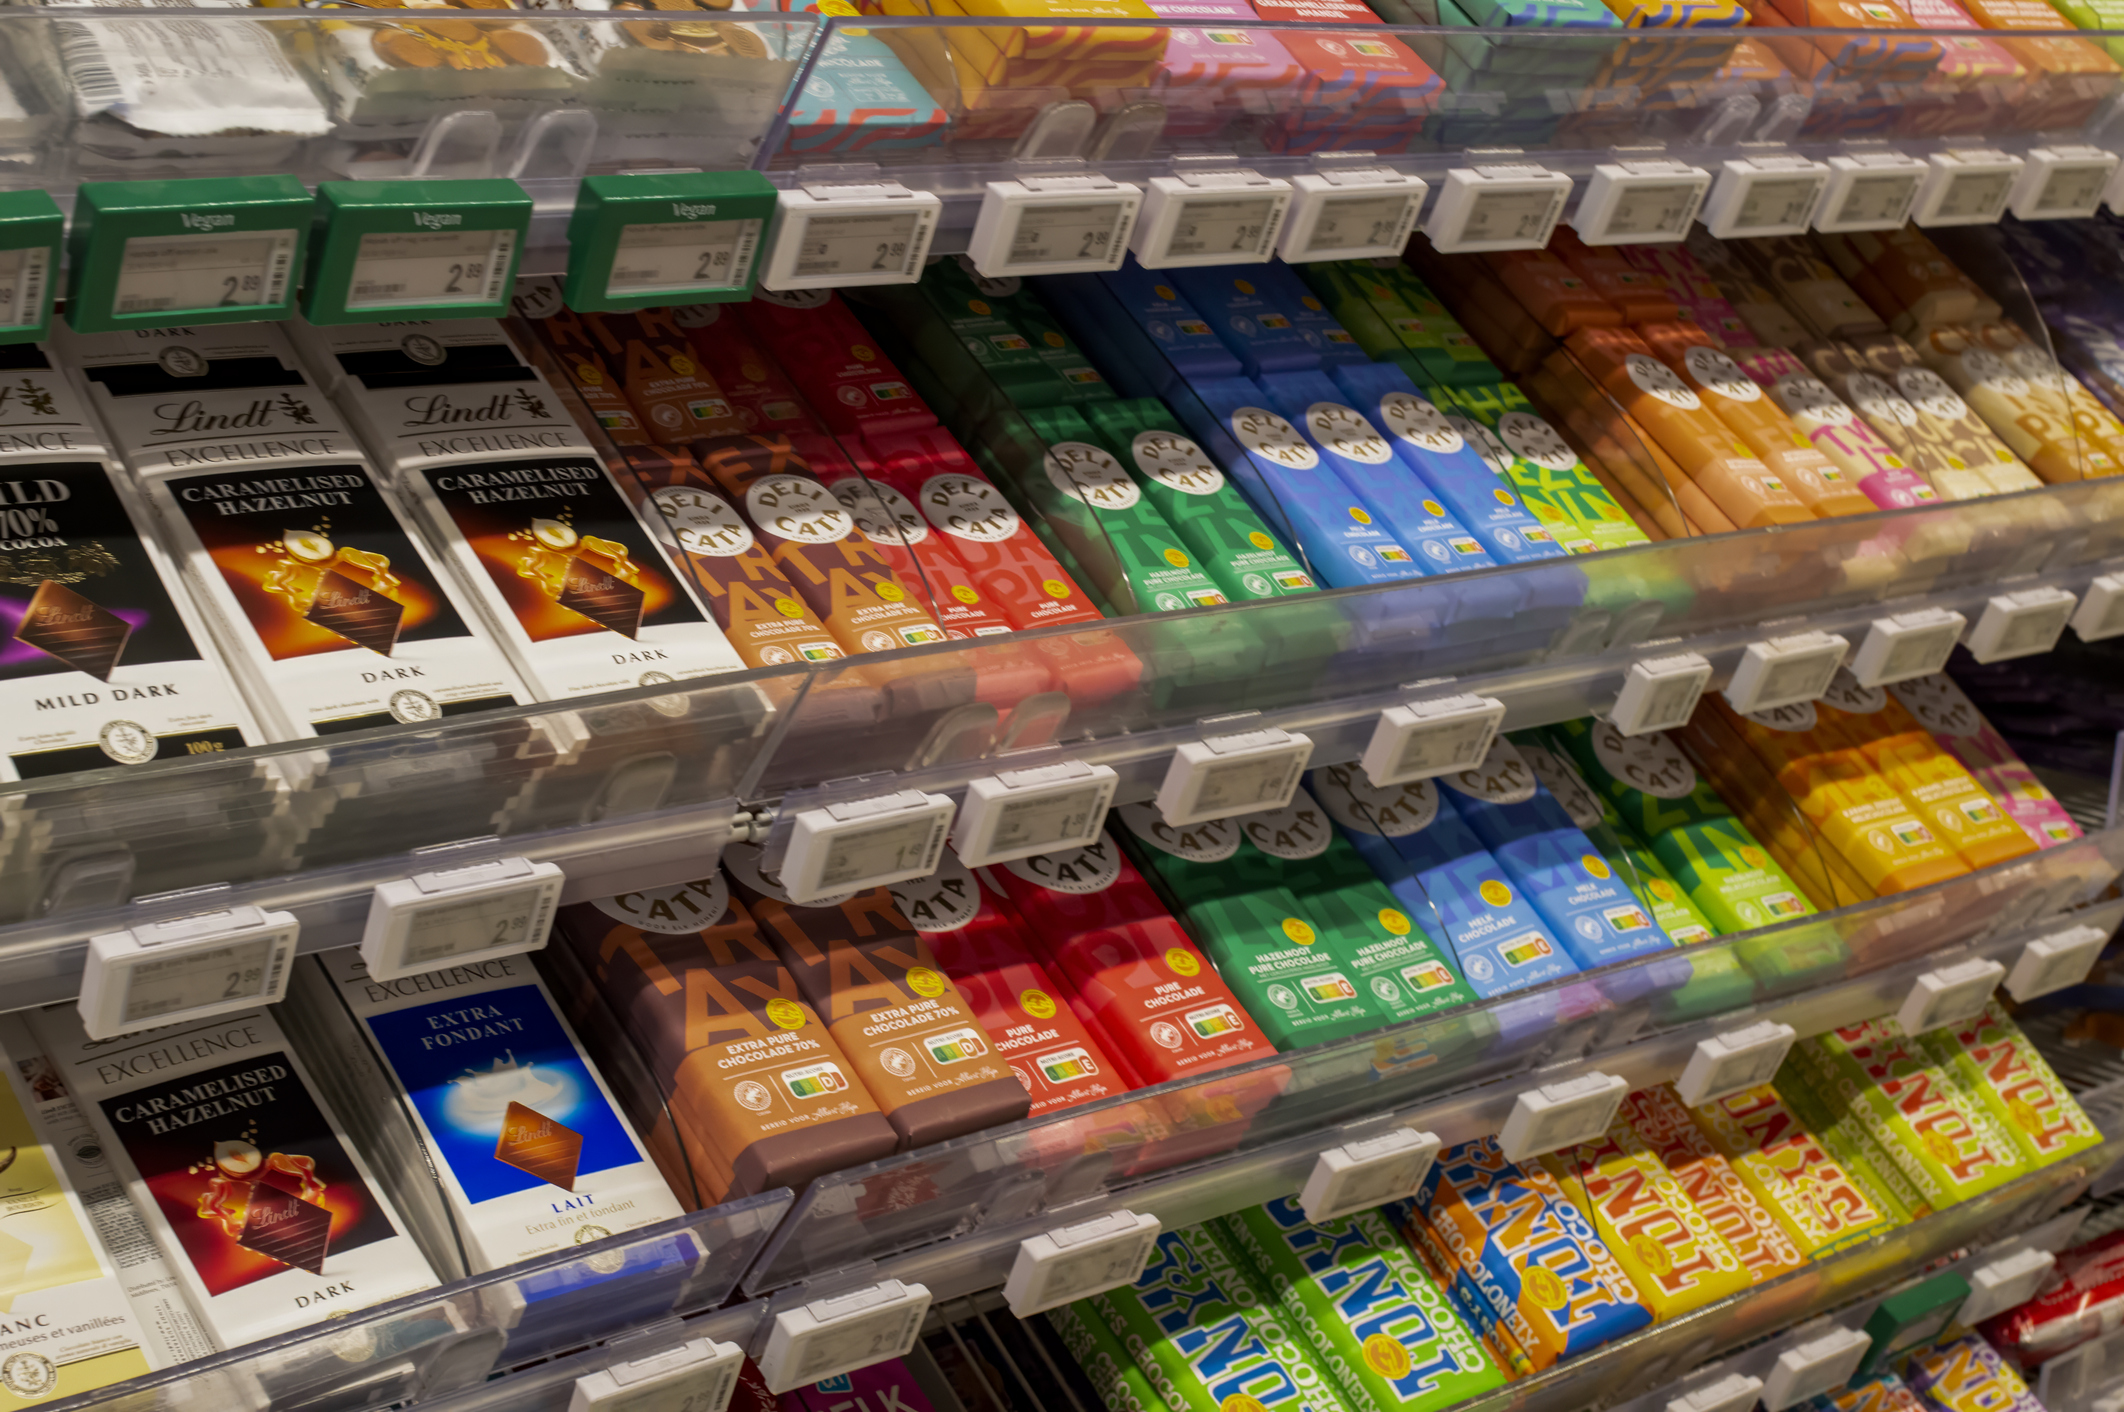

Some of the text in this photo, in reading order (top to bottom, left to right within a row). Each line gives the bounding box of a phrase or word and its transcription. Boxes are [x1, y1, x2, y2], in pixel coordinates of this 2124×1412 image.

[181, 213, 235, 231] Vegan
[413, 211, 462, 231] Vegan
[672, 202, 716, 219] Vegan
[693, 251, 713, 279] 2
[871, 242, 889, 270] 2
[221, 276, 240, 306] 2
[443, 264, 463, 293] 2
[149, 399, 277, 436] Lindt
[403, 394, 514, 428] Lindt
[1241, 413, 1290, 435] DELI
[1316, 408, 1363, 431] DELI
[165, 438, 339, 468] EXCELLENCE
[418, 431, 573, 458] EXCELLENCE
[1142, 435, 1196, 460] DELI
[1258, 440, 1309, 464] CATA
[1332, 434, 1384, 459] CATA
[1057, 448, 1112, 474] DELI
[181, 473, 365, 503] CARAMELISED
[436, 465, 600, 492] CARAMELISED
[1157, 462, 1212, 489] CATA
[0, 479, 72, 505] ILD
[467, 482, 593, 506] HAZELNUT
[758, 480, 824, 508] DELI
[931, 481, 990, 508] DELI
[1072, 477, 1128, 502] CATA
[213, 490, 354, 517] HAZELNUT
[658, 491, 724, 519] DELI
[775, 508, 842, 539] CATA
[854, 512, 917, 539] CATA
[947, 505, 1007, 535] CATA
[676, 522, 741, 549] CATA
[851, 610, 903, 626] CHOCOLADE
[855, 601, 907, 618] EXTRA PURE
[946, 605, 968, 614] PURE
[1030, 604, 1078, 619] CHOCOLADE
[1038, 600, 1060, 611] PURE
[749, 624, 803, 639] CHOCOLADE
[755, 617, 806, 632] EXTRA PURE
[613, 648, 670, 666] DARK
[361, 665, 427, 684] DARK
[35, 683, 180, 712] MILD DARK
[184, 740, 226, 756] 100g
[1349, 781, 1425, 827] CATA
[1151, 818, 1227, 852] CATA
[1247, 809, 1315, 849] CATA
[1027, 842, 1107, 883] CATA
[613, 877, 714, 922] CATA
[1568, 888, 1618, 906] CHOCOLADE
[1574, 883, 1598, 894] MELK
[1457, 915, 1518, 944] CHOCOLADE
[1467, 912, 1496, 930] MELK
[1254, 946, 1313, 964] HAZELNOOT
[1350, 940, 1429, 970] PURE CHOCOLADE
[1356, 935, 1409, 957] HAZELNOOT
[1247, 952, 1333, 976] PURE CHOCOLADE
[222, 971, 242, 998] 2
[364, 957, 517, 1005] EXCELLENCE
[1154, 981, 1183, 996] PURE
[1143, 985, 1206, 1010] CHOCOLADE
[425, 1003, 506, 1031] EXTRA
[862, 1005, 960, 1037] CHOCOLADE 70%
[869, 999, 940, 1024] EXTRA PURE
[1227, 1014, 1241, 1027] E
[420, 1017, 525, 1051] FONDANT
[725, 1031, 800, 1056] EXTRA PURE
[994, 1028, 1061, 1053] CHOCOLADE
[1005, 1023, 1036, 1039] PURE
[97, 1025, 263, 1087] EXCELLENCE
[716, 1039, 821, 1070] CHOCOLADE 70%
[960, 1042, 975, 1054] D
[1081, 1058, 1095, 1072] E
[114, 1064, 289, 1124] CARAMELISED
[820, 1076, 836, 1089] D
[146, 1086, 277, 1136] HAZELNUT
[507, 1120, 554, 1146] Lindt
[250, 1199, 302, 1232] Lindt
[551, 1193, 595, 1214] LAIT
[525, 1220, 557, 1236] Extra
[576, 1211, 589, 1223] et
[590, 1198, 636, 1219] fondant
[1553, 1145, 1720, 1297] TONY
[1428, 1203, 1541, 1356] CHOCOLONELY
[294, 1279, 357, 1309] DARK
[0, 1314, 51, 1338] ANC
[51, 1314, 126, 1340] et vanillées
